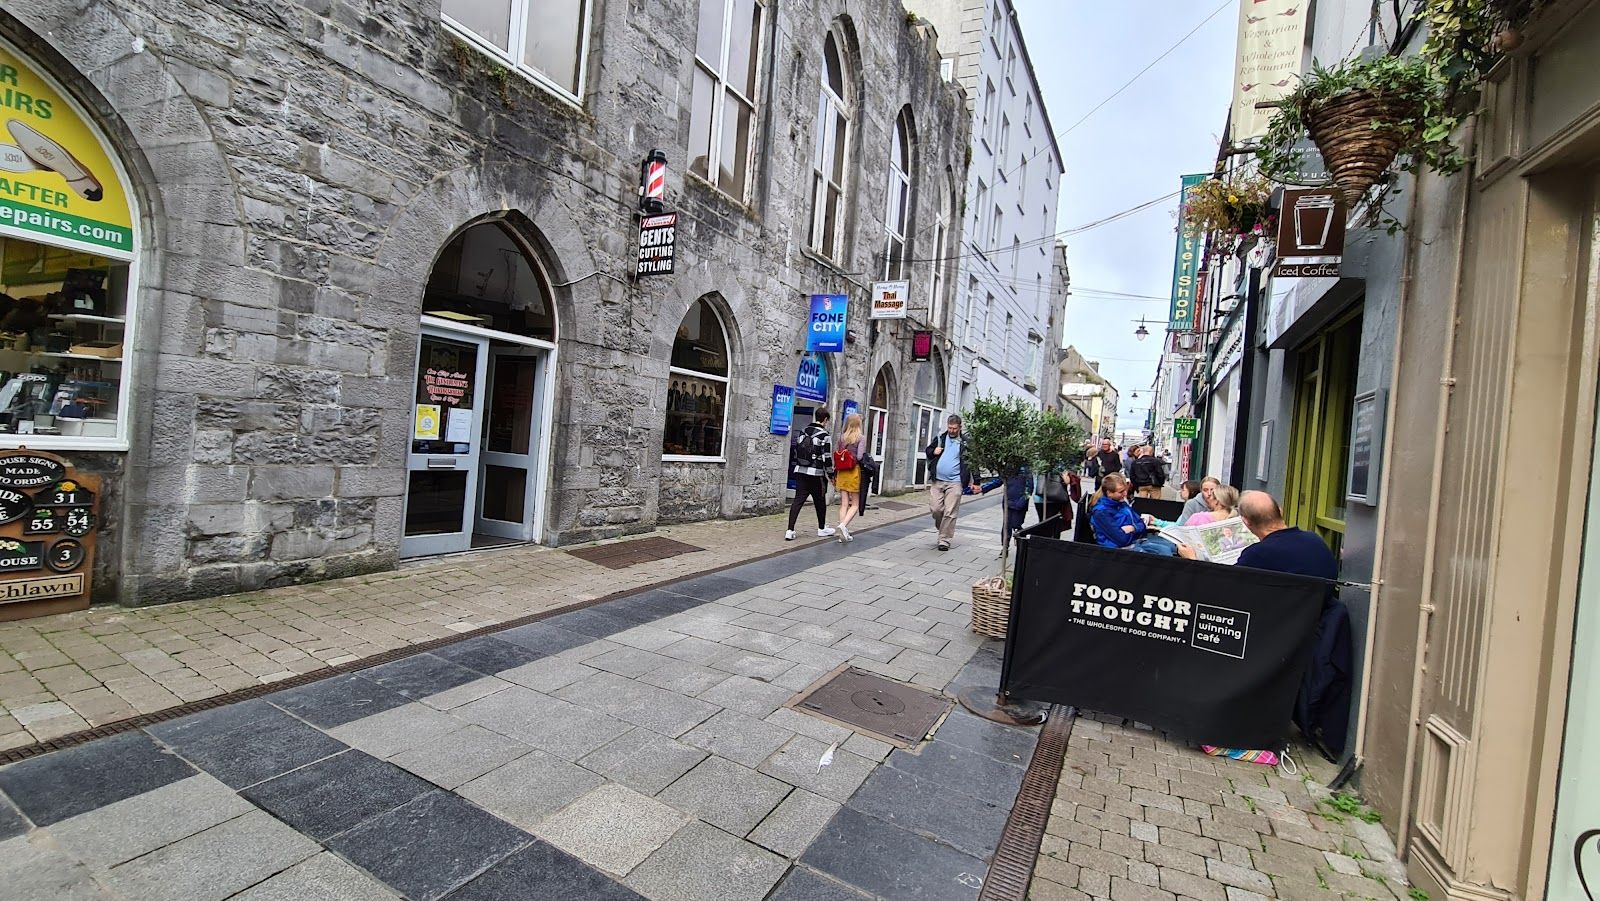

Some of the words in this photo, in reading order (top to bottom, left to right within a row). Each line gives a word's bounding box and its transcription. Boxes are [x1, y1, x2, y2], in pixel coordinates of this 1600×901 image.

[1243, 24, 1298, 39] Vegetarian
[1264, 40, 1272, 48] &
[1241, 46, 1296, 63] Wholefood
[1240, 60, 1296, 76] Restaurant
[0, 89, 52, 120] IRS
[640, 227, 674, 247] GENTS
[640, 245, 674, 259] CUTTING
[638, 260, 672, 272] STYLING
[1278, 266, 1299, 276] Iced
[1302, 264, 1338, 276] Coffee
[882, 291, 896, 300] Thai
[1175, 276, 1192, 319] Shop
[874, 300, 904, 310] Massage
[812, 312, 844, 322] FONE
[813, 322, 842, 332] CITY
[800, 360, 820, 377] FONE
[800, 374, 818, 388] CITY
[775, 386, 792, 395] FONE
[776, 394, 791, 403] CITY
[28, 456, 58, 470] SIGNS
[14, 475, 52, 485] ORDER
[54, 493, 76, 504] 31
[30, 519, 54, 530] 55
[67, 516, 88, 526] 54
[60, 550, 71, 560] 3
[1072, 582, 1134, 605] FOOD
[1142, 594, 1192, 616] FOR
[1070, 600, 1188, 632] THOUGHT
[1200, 612, 1234, 626] award
[1073, 618, 1086, 626] THE
[1086, 620, 1128, 633] WHOLESOME
[1128, 628, 1147, 636] FOOD
[1148, 632, 1181, 644] COMPANY
[1197, 631, 1220, 644] café
[1198, 622, 1242, 640] winning
